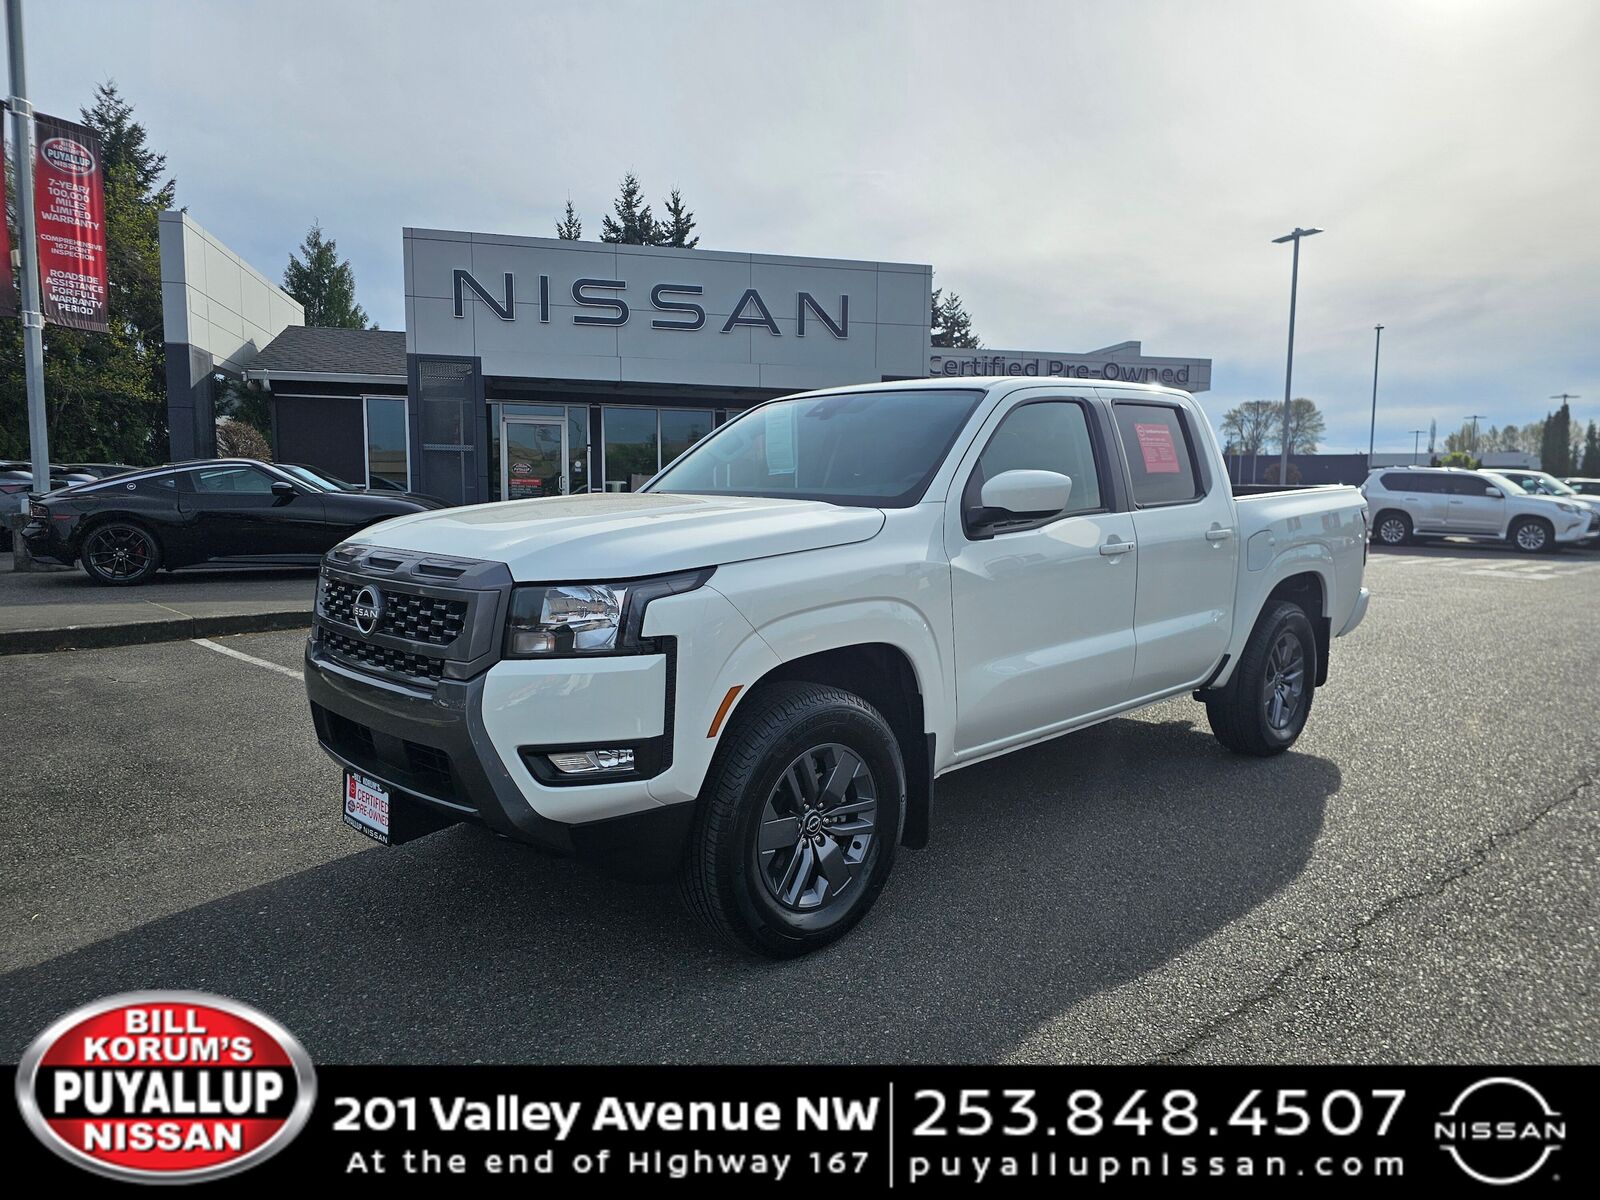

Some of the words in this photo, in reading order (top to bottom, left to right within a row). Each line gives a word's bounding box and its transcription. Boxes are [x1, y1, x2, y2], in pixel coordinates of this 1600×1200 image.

[47, 148, 91, 167] PUYALLUP
[48, 178, 90, 195] 7-YEAR/
[47, 187, 90, 203] 100,000
[50, 204, 92, 220] LIMITED
[55, 197, 87, 211] MILES
[41, 210, 100, 231] WARRANTY
[40, 233, 103, 252] COMPREHENSIVE
[69, 245, 91, 255] POINT
[50, 247, 95, 262] INSPECTION
[45, 276, 104, 294] ASSISTANCE
[49, 269, 100, 285] ROADSIDE
[48, 293, 103, 309] WARRANTY
[52, 285, 75, 296] FOR
[74, 289, 97, 301] FULL
[57, 302, 94, 316] PERIOD
[452, 268, 850, 340] NISSAN
[929, 355, 1040, 378] Certified
[1050, 359, 1190, 384] Pre-Owned
[354, 607, 378, 618] SSAN
[357, 789, 389, 814] CERTIFIED
[356, 802, 389, 826] PRE-OWNED
[363, 826, 388, 844] NISSAN
